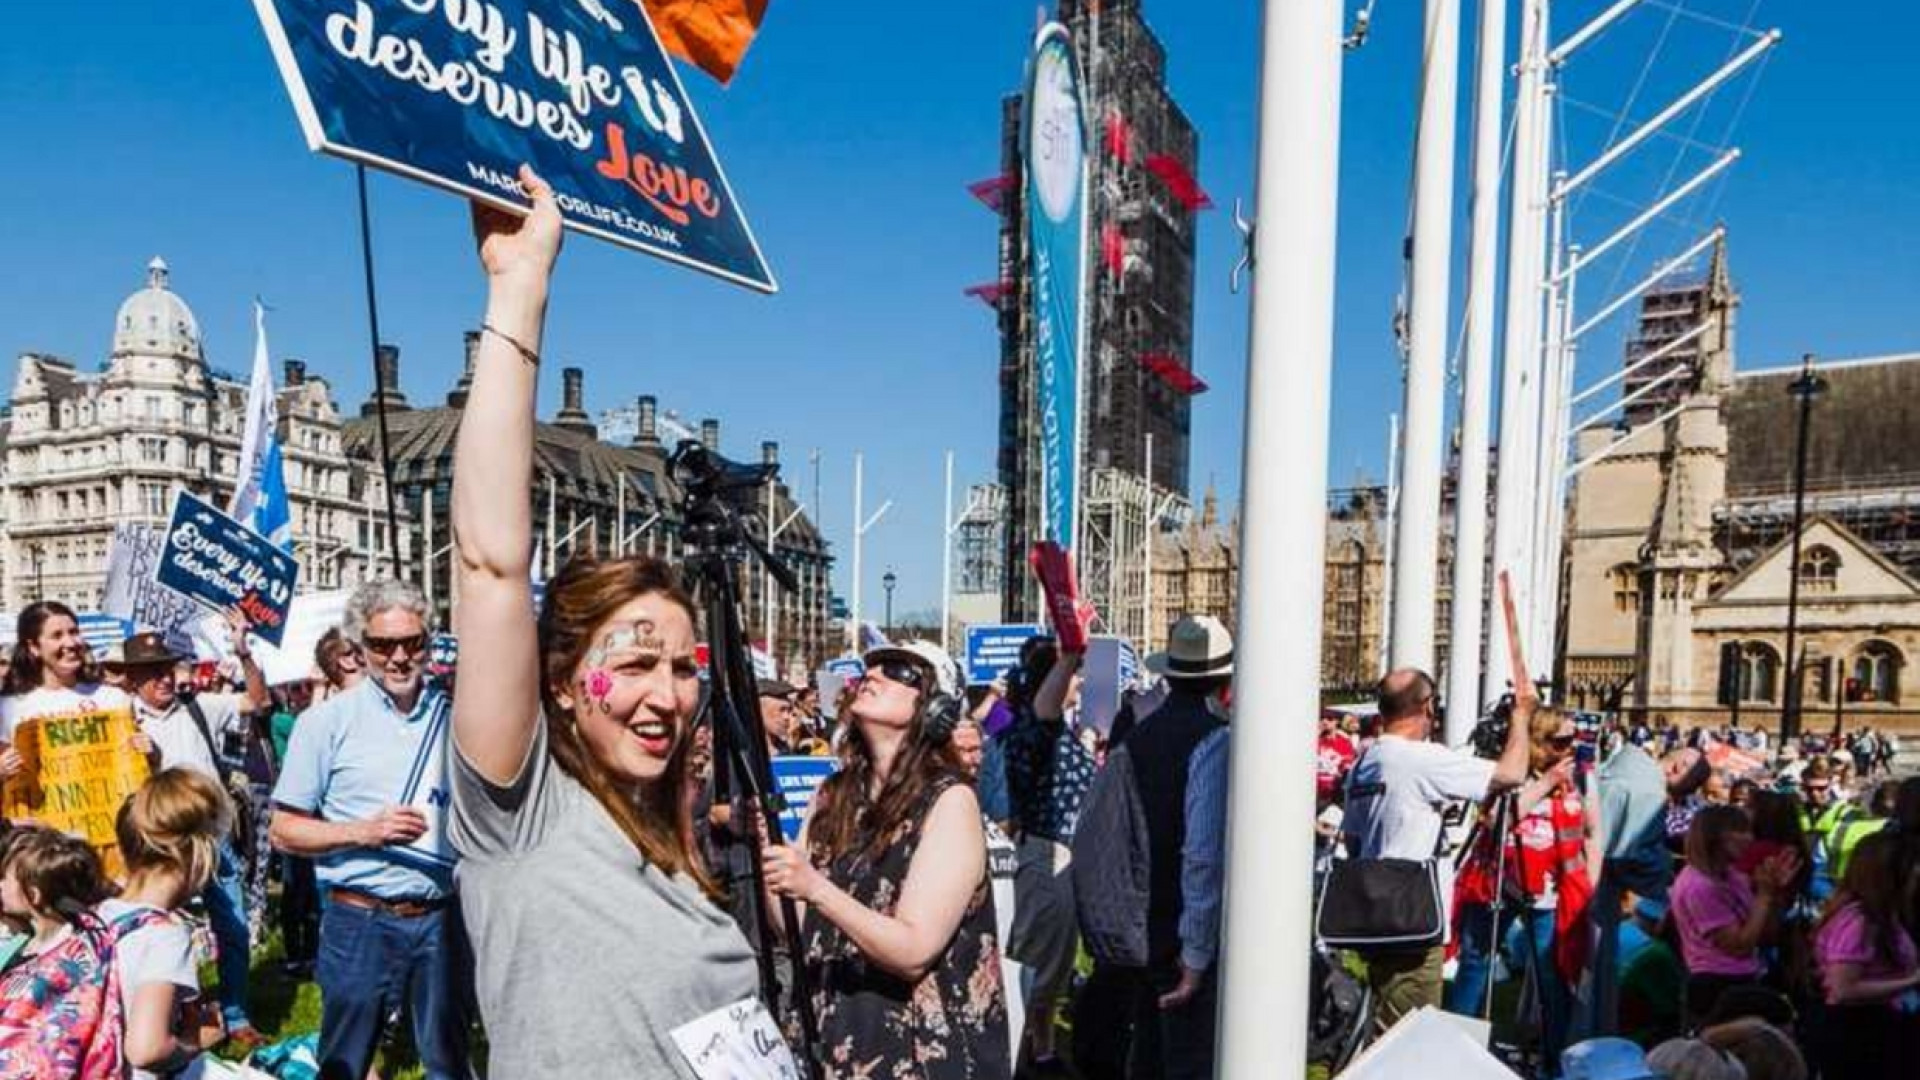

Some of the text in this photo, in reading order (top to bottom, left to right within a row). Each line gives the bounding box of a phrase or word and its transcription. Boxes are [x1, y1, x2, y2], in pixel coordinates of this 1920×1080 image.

[528, 12, 621, 115] life
[325, 0, 720, 224] deserves Love
[466, 160, 682, 248] MARCORLIFE.CO.UK
[171, 521, 241, 576] Every
[45, 715, 110, 748] RIGHT
